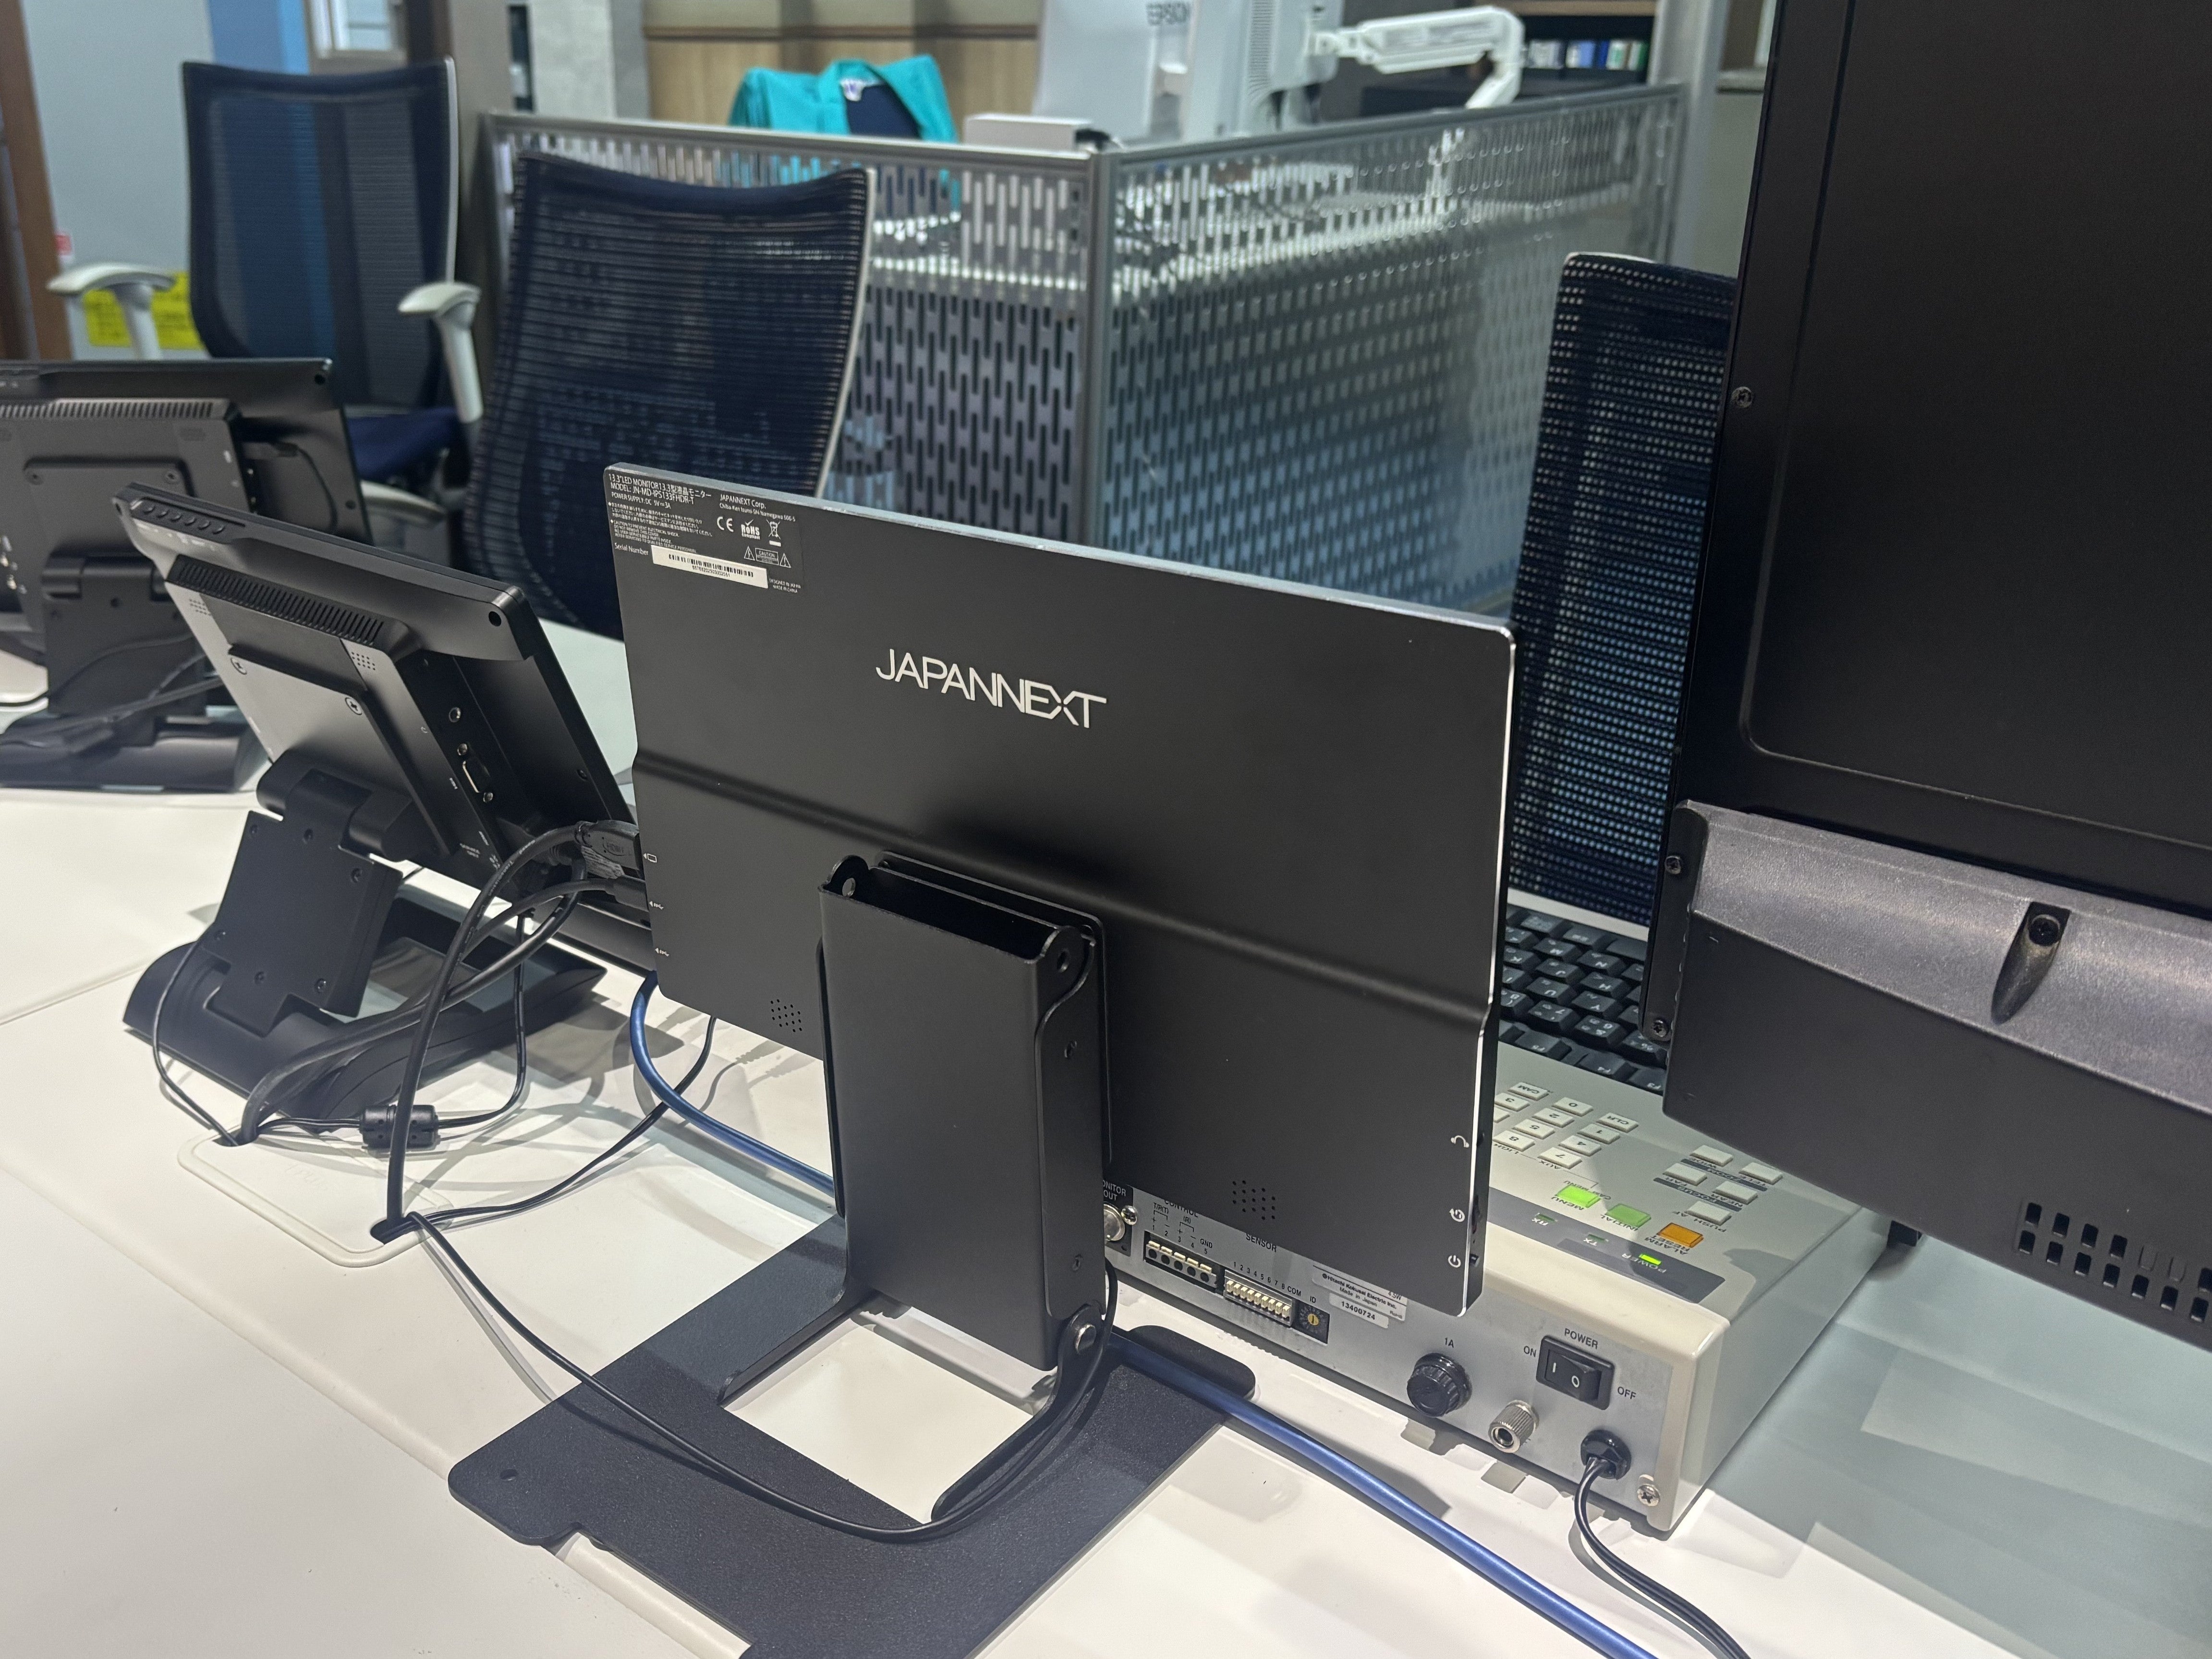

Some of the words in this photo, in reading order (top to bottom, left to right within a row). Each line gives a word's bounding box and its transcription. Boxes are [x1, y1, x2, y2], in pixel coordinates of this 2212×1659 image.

[720, 494, 750, 506] JAPANNEXT
[876, 648, 1107, 729] JAPANNEXT
[1518, 1085, 1539, 1094] CAM
[1606, 1115, 1629, 1125] CLR
[1494, 1144, 1519, 1155] LIGH
[1539, 1160, 1561, 1170] AUX
[1551, 1196, 1585, 1210] MENU
[1531, 1218, 1549, 1226] RX
[1600, 1214, 1639, 1232] INITIAL
[1693, 1218, 1727, 1233] PUSH
[1200, 1237, 1213, 1249] GND
[1245, 1232, 1277, 1253] SENSOR
[1583, 1238, 1598, 1246] TX
[1644, 1236, 1689, 1255] ALARM
[1621, 1253, 1667, 1273] POWER
[1287, 1285, 1302, 1297] COM
[1339, 1286, 1353, 1296] Made
[1362, 1297, 1378, 1307] Japan
[1310, 1295, 1317, 1304] ID
[1367, 1292, 1386, 1305] Electric
[1341, 1300, 1376, 1321] 13400724
[1444, 1337, 1455, 1349] 1A
[1564, 1327, 1599, 1350] POWER
[1523, 1345, 1537, 1358] ON
[1616, 1386, 1637, 1401] OFF
